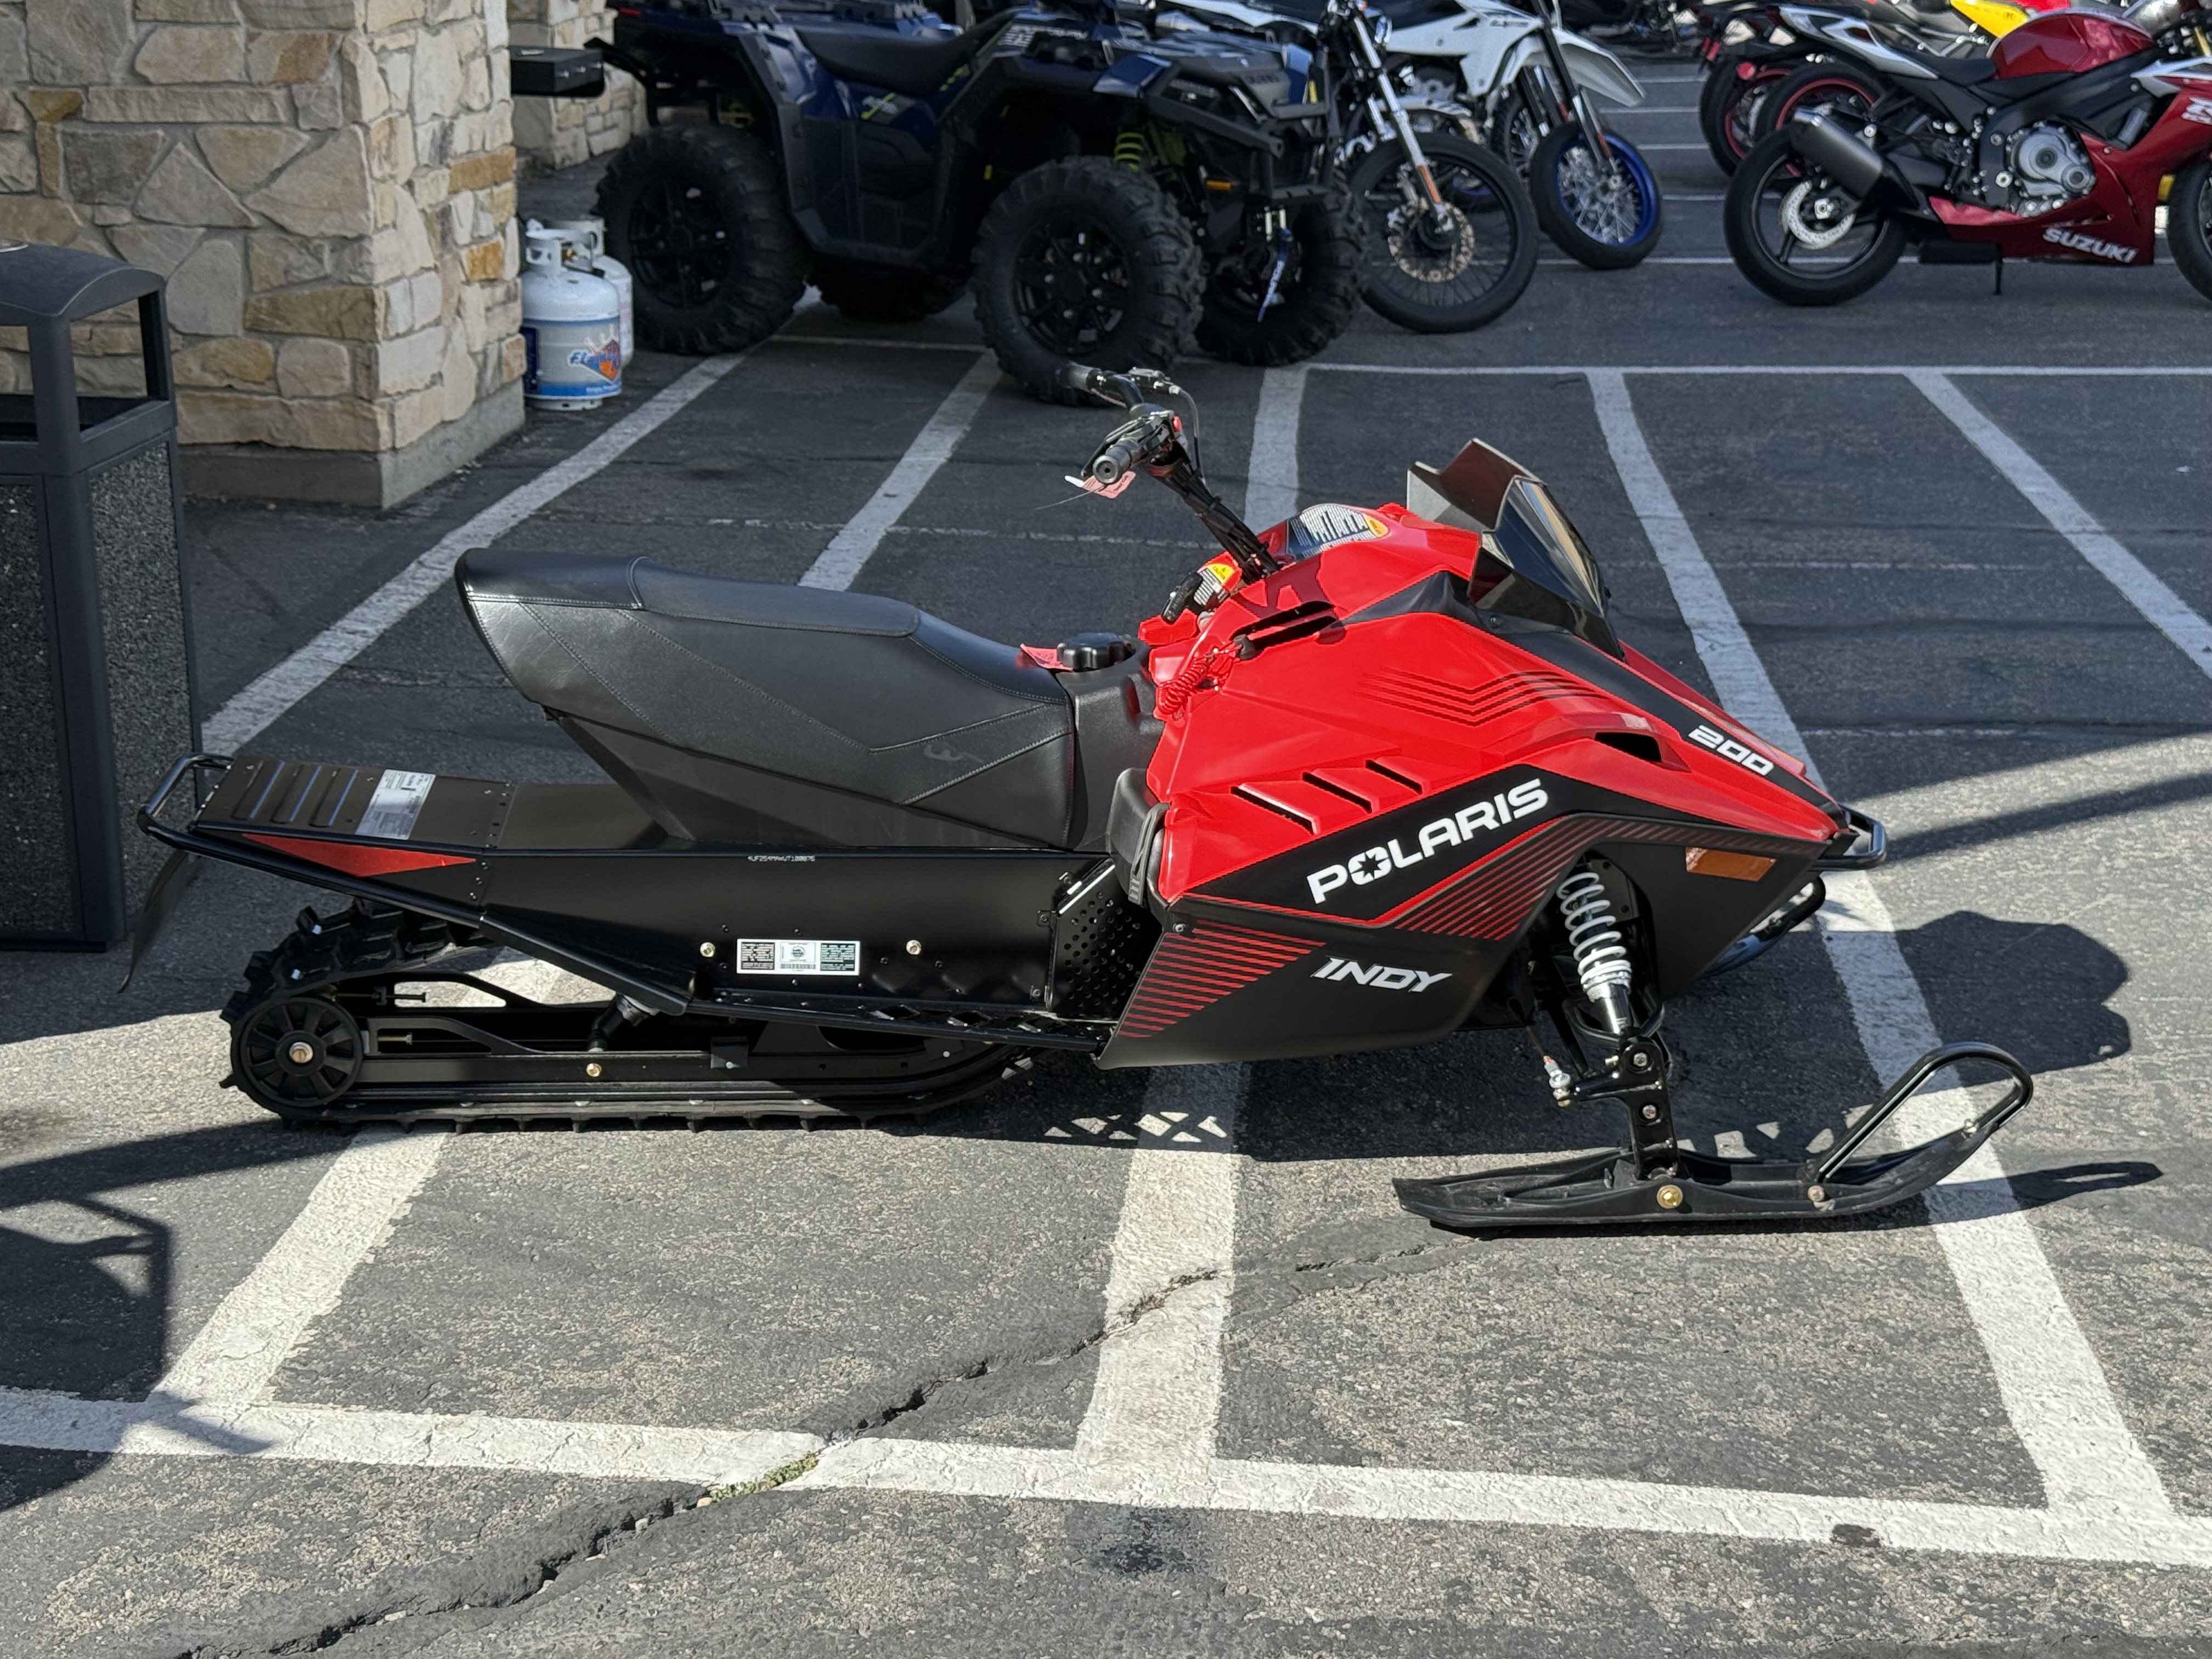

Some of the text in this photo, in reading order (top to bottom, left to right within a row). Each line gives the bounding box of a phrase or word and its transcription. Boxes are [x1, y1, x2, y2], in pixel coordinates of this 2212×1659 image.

[2042, 227, 2140, 263] SUZUKI
[1688, 725, 1774, 776] 200
[1306, 777, 1549, 905] POLARIS
[1311, 956, 1453, 992] INDY
